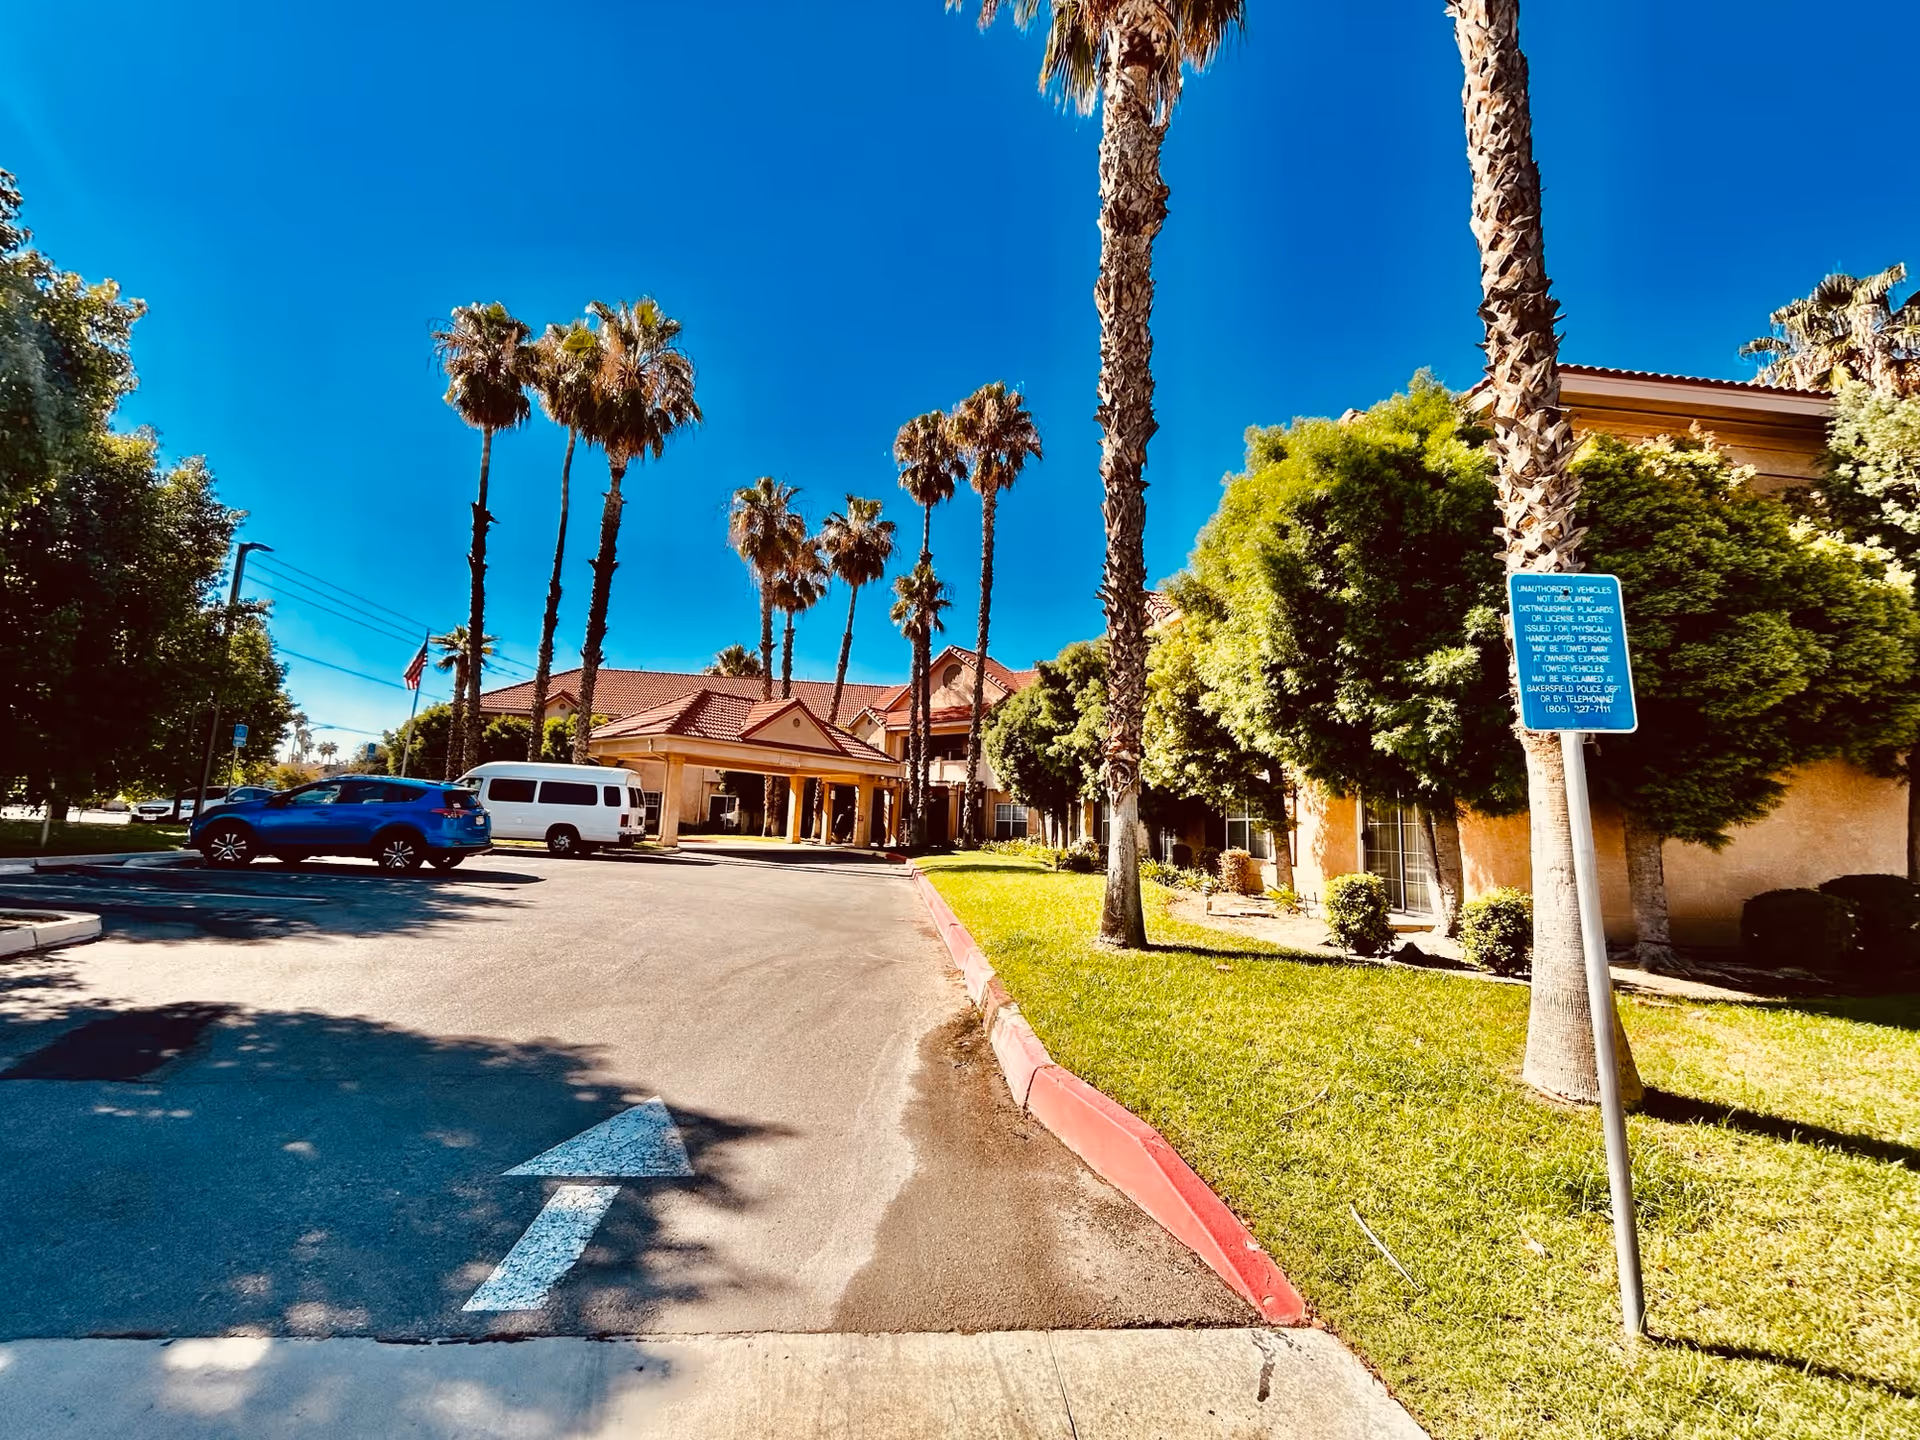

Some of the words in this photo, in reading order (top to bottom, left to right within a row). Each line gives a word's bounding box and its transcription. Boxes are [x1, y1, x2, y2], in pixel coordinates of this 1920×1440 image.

[1554, 595, 1594, 603] DISPLAYING
[1562, 675, 1603, 683] RECLAIMED
[1566, 695, 1613, 703] TELEPHONING
[1545, 705, 1570, 713] (805)
